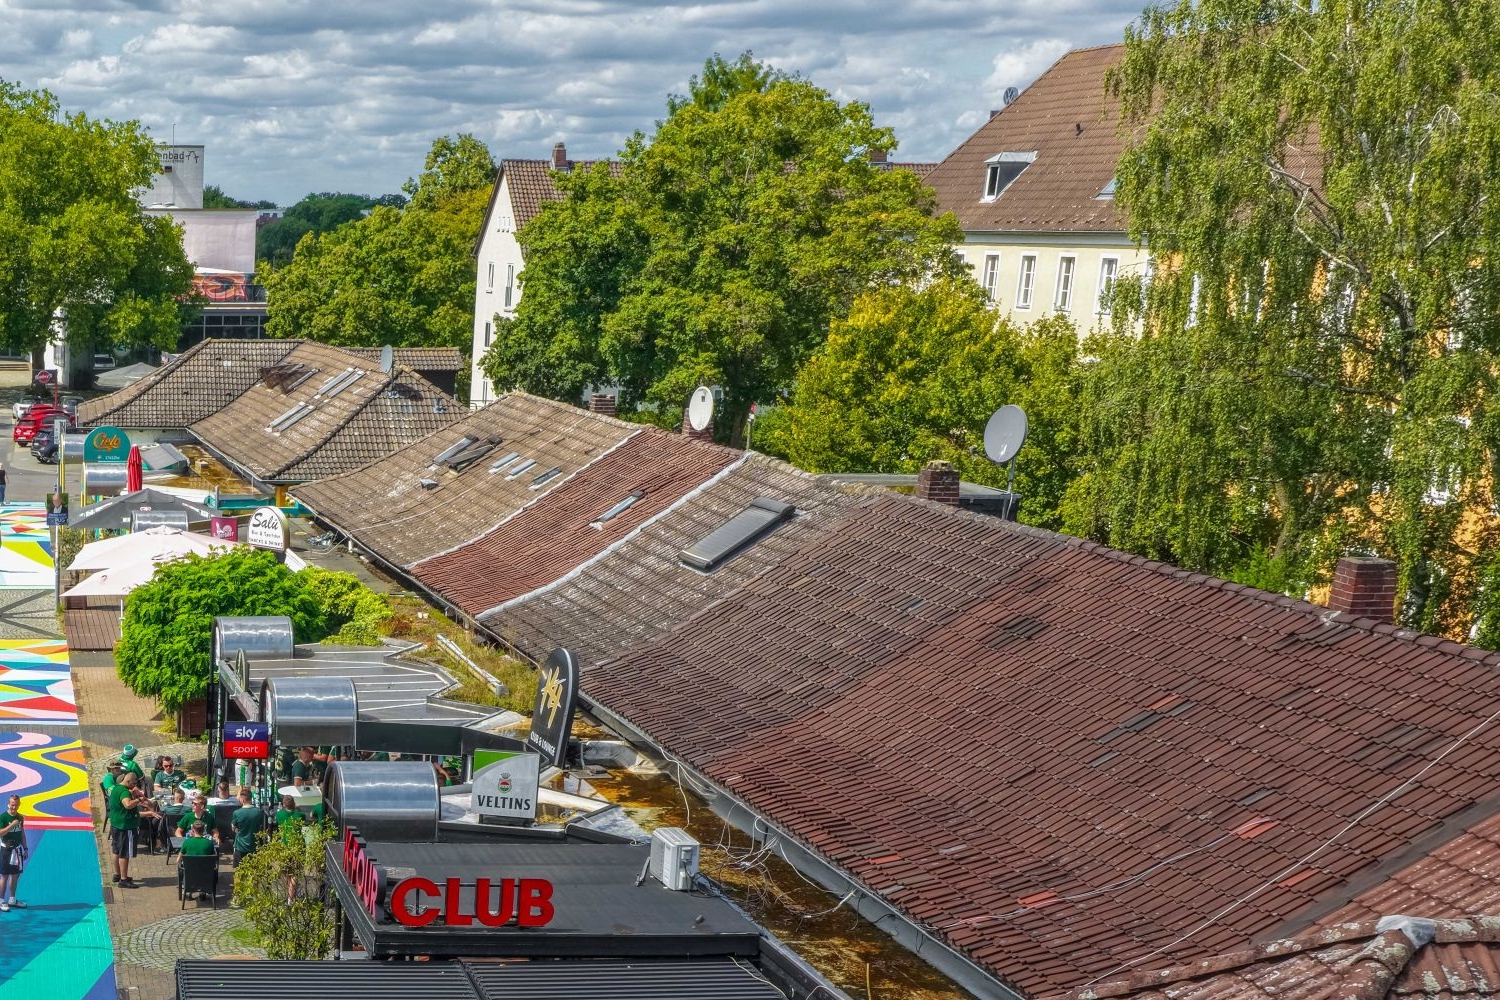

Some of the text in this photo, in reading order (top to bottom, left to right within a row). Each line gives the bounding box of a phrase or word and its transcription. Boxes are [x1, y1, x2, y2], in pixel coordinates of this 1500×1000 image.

[235, 726, 257, 740] sky
[232, 746, 258, 754] sport
[477, 794, 531, 810] VELTINS
[391, 877, 554, 927] CLUB
